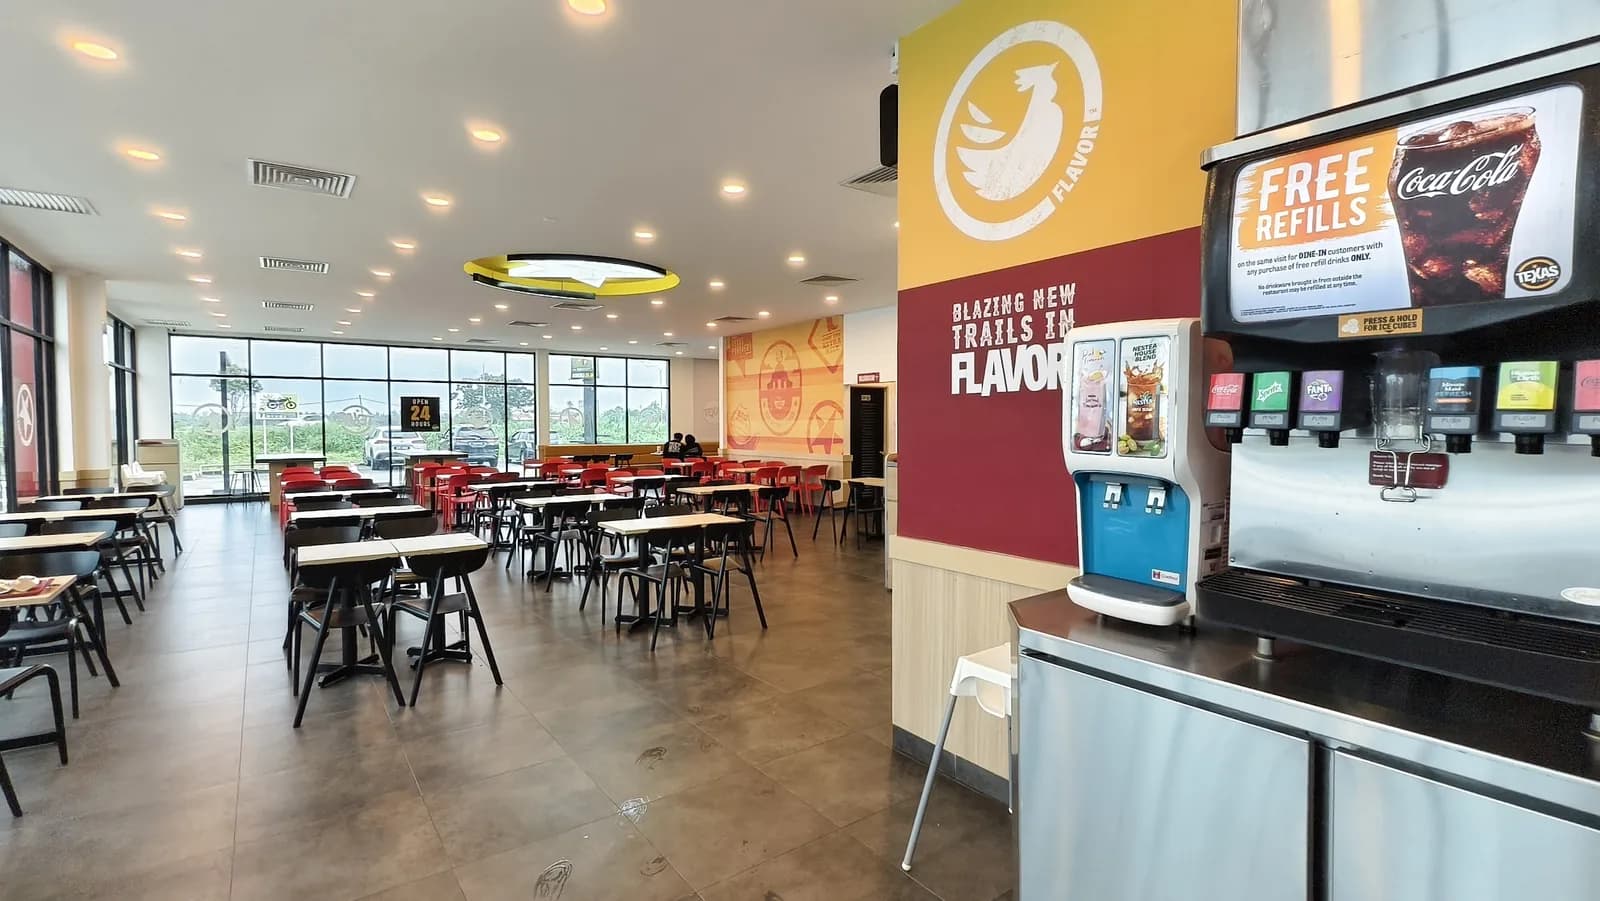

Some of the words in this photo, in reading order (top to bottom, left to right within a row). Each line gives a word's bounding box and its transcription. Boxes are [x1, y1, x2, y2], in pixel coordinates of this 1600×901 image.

[1052, 125, 1100, 203] FLAVOR
[1397, 143, 1524, 200] Coca-Cola
[1258, 147, 1374, 212] FREE
[1256, 196, 1367, 242] REFILLS
[1256, 258, 1272, 266] same
[1274, 253, 1287, 262] visit
[1288, 252, 1298, 260] for
[1298, 249, 1326, 260] DINE-IN
[1328, 245, 1365, 255] customers
[1366, 242, 1383, 250] with
[1247, 268, 1257, 276] any
[1258, 264, 1287, 275] purchase
[1288, 262, 1295, 270] of
[1296, 260, 1310, 269] free
[1310, 258, 1326, 268] refill
[1328, 256, 1350, 265] drinks
[1350, 253, 1372, 262] ONLY.
[1292, 278, 1312, 288] brought
[1318, 276, 1332, 284] from
[1332, 274, 1352, 282] outside
[1516, 265, 1559, 284] TEXAS
[1307, 284, 1326, 292] refilled
[1333, 282, 1342, 290] any
[952, 293, 1024, 322] BLAZING
[1033, 283, 1076, 310] NEW
[1364, 316, 1388, 324] PRESS
[1397, 314, 1418, 322] HOLD
[952, 315, 1033, 350] TRAILS
[1045, 308, 1075, 340] IN
[1364, 324, 1378, 332] FOR
[1132, 344, 1158, 352] NESTEA
[1134, 348, 1156, 356] HOUSE
[1135, 354, 1156, 362] BLEND
[1306, 384, 1333, 394] FANTA
[410, 406, 430, 420] 24
